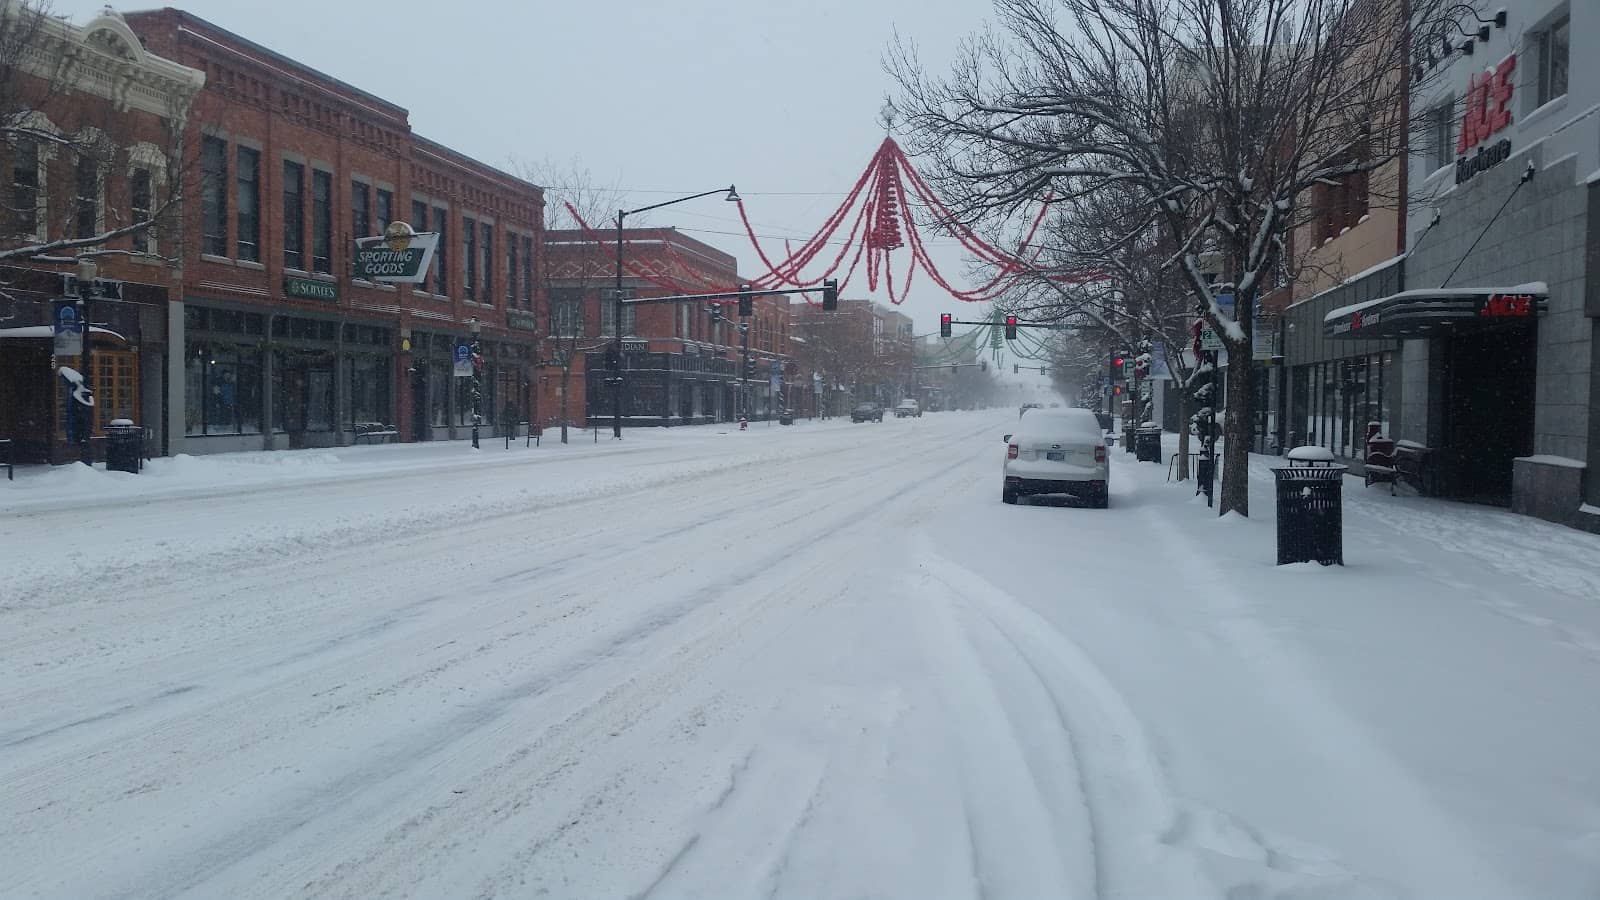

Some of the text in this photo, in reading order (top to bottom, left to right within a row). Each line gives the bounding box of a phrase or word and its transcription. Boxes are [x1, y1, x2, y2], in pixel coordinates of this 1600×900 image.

[1456, 53, 1517, 155] ACE
[1456, 138, 1512, 185] Hardware
[358, 250, 413, 263] SPORTING
[364, 262, 405, 274] GOODS
[1480, 295, 1531, 316] ACE
[621, 343, 645, 351] IDIAN
